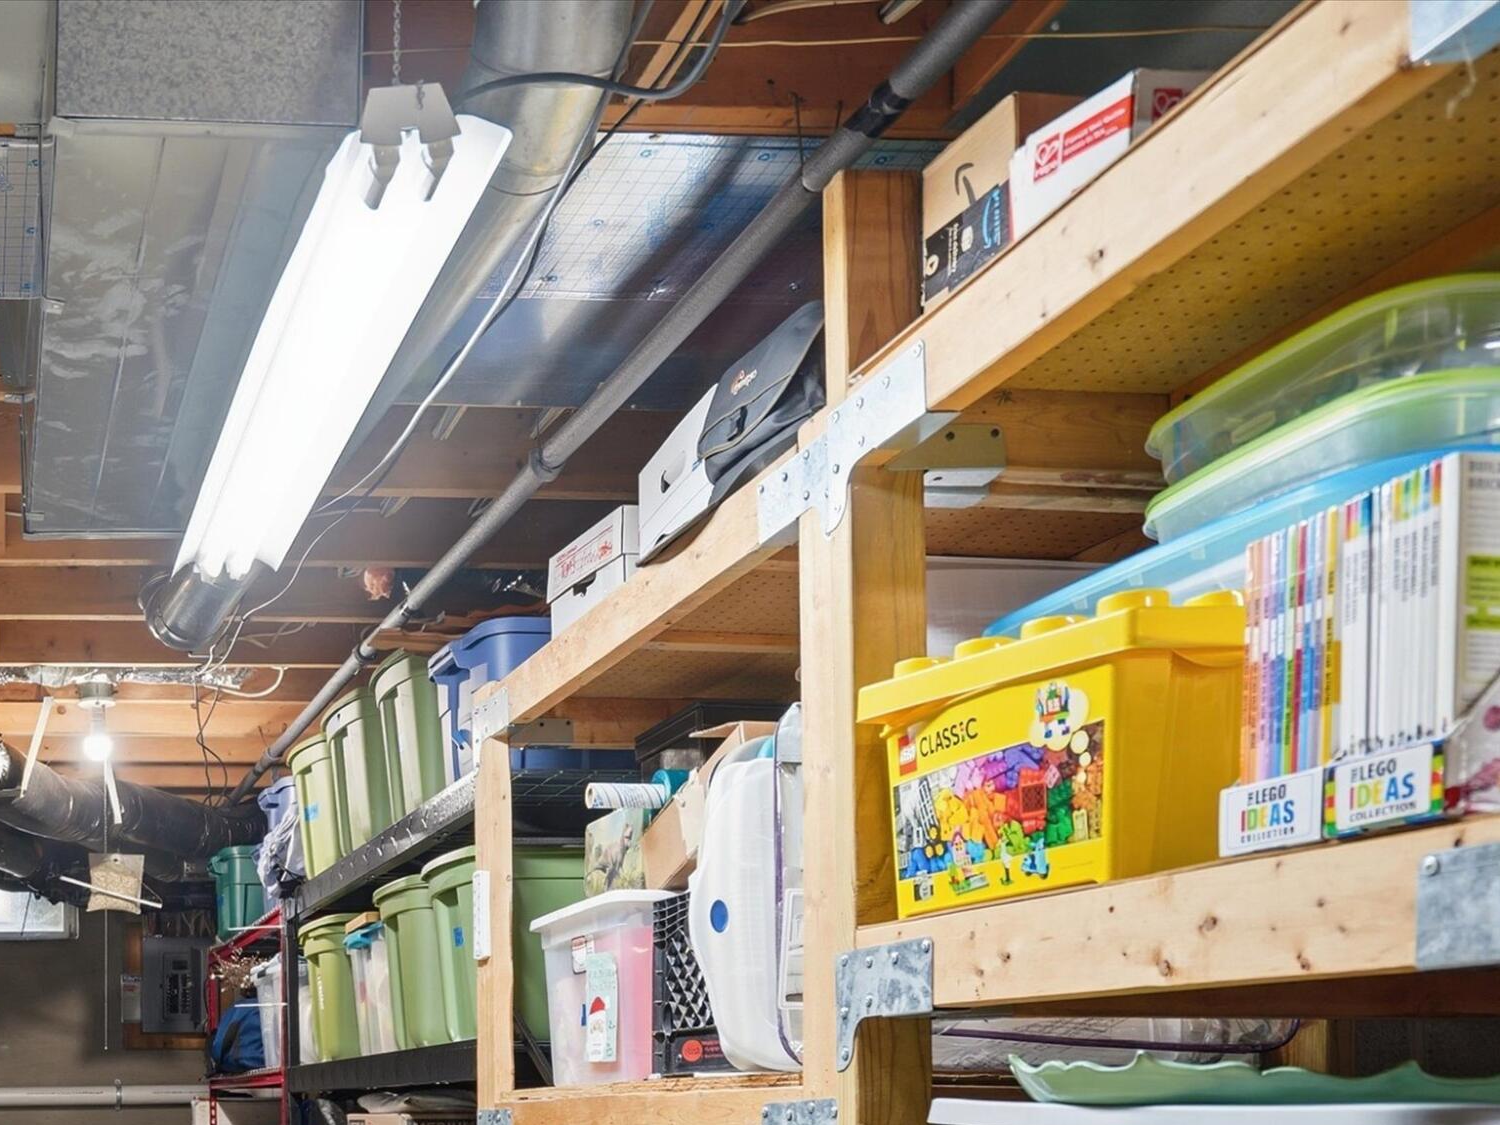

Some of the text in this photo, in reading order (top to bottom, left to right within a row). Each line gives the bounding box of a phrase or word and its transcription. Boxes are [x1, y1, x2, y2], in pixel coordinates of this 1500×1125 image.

[1360, 758, 1397, 780] LEGO
[1255, 784, 1287, 805] LEGO
[1349, 772, 1415, 810] IDEAS
[1240, 800, 1295, 832] IDEAS
[1350, 800, 1417, 823] COLLECTION
[1240, 827, 1295, 844] COLLECTION
